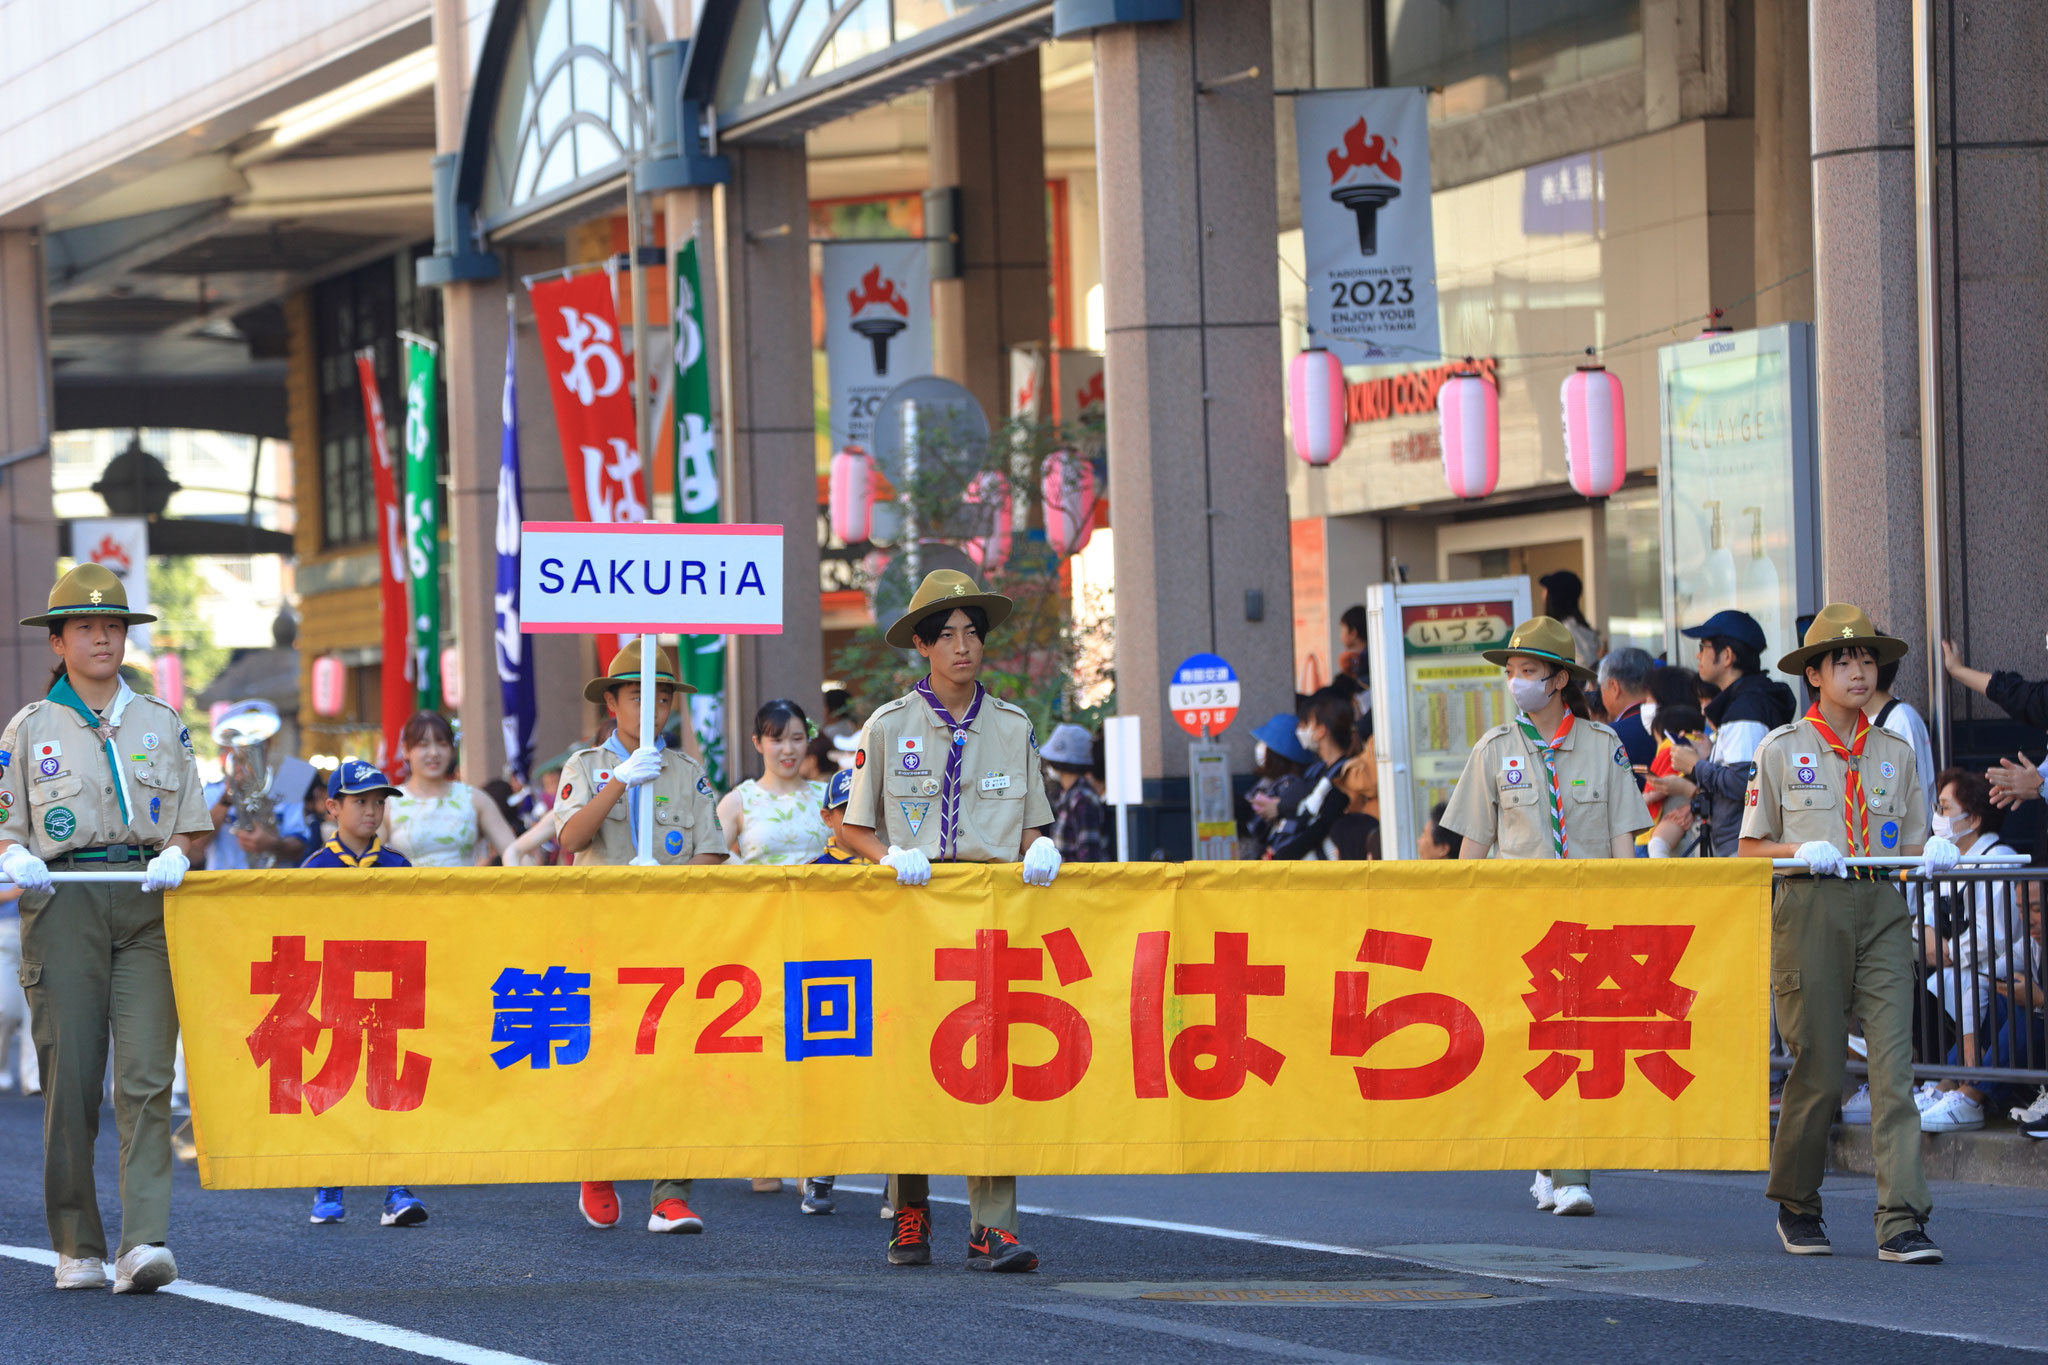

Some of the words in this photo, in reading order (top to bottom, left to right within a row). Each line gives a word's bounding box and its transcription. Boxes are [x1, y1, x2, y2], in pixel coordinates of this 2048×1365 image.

[1330, 278, 1415, 308] 2023
[1331, 310, 1376, 324] ENJOY
[1379, 308, 1416, 321] YOUR
[1690, 411, 1765, 451] CLAYGE
[538, 558, 766, 596] SAKURiA
[1426, 604, 1488, 619] 市バス
[1420, 620, 1495, 643] いづろ
[1181, 688, 1228, 706] いづろ
[1183, 710, 1227, 726] のりば
[246, 935, 432, 1117] 祝
[491, 958, 873, 1070] 第72回
[930, 920, 1697, 1105] おはら祭
